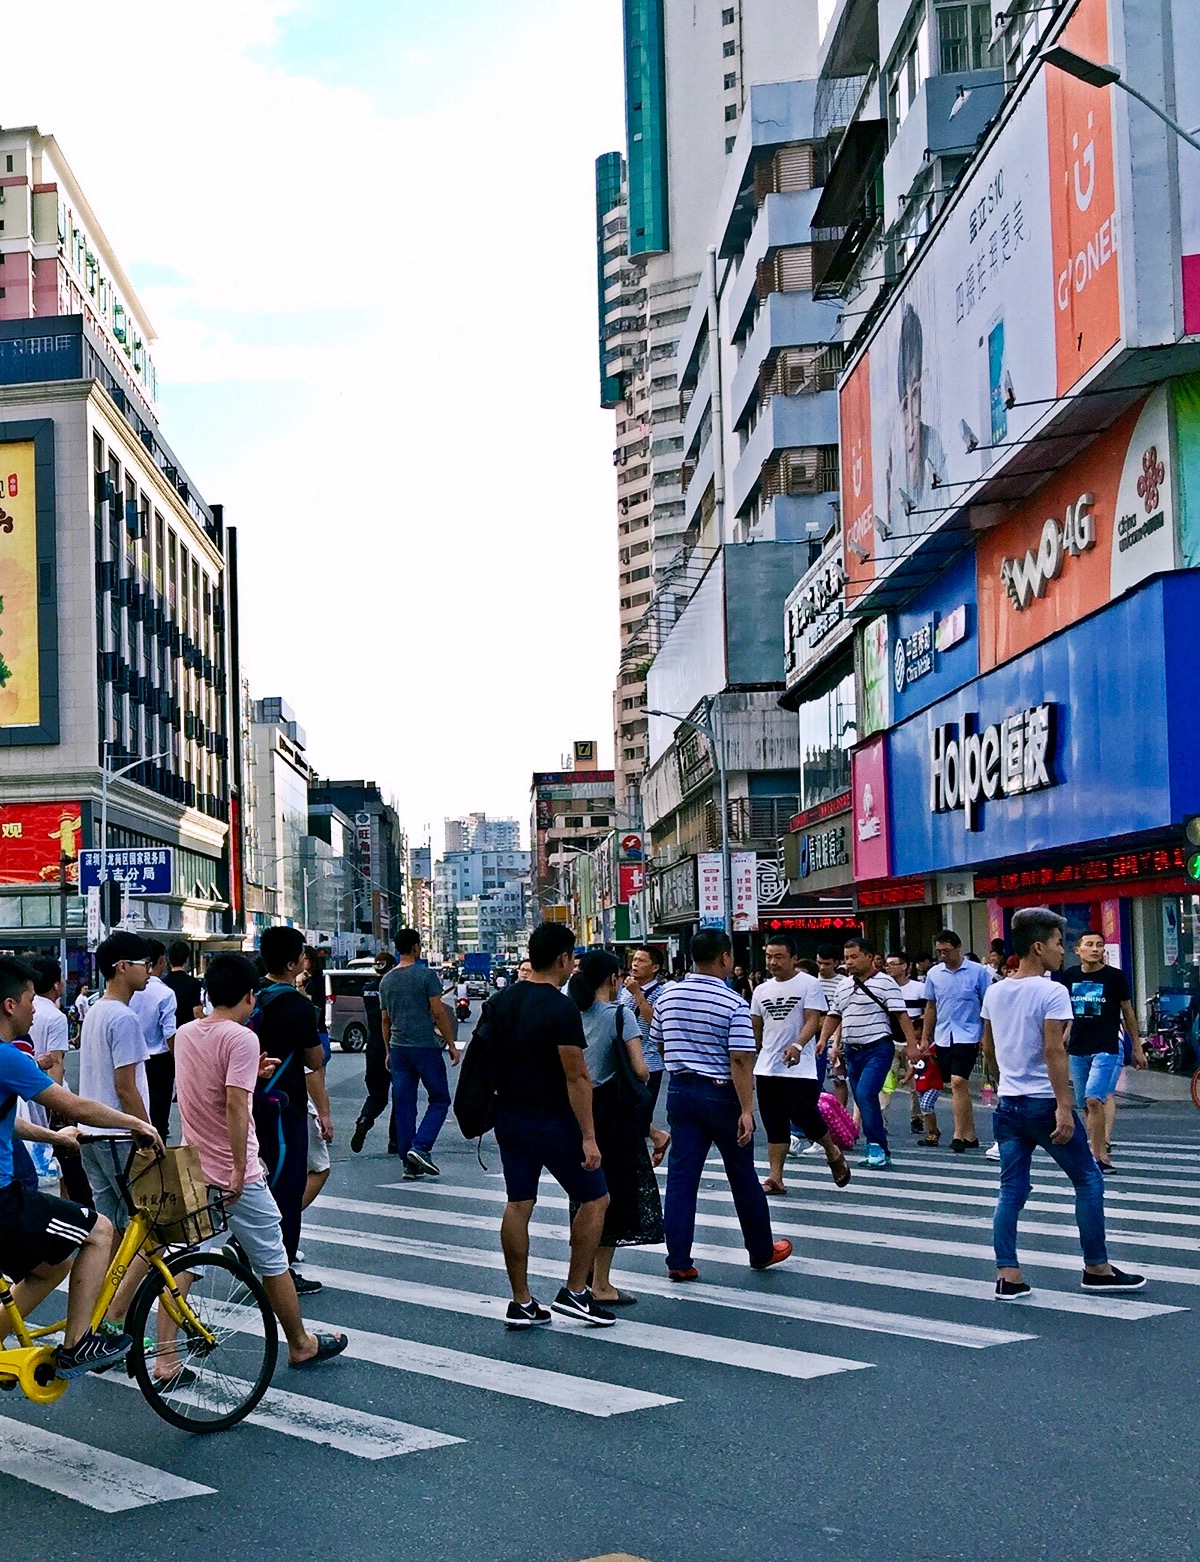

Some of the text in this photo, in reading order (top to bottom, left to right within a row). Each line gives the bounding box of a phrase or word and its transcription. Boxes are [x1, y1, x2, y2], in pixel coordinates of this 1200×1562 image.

[930, 713, 1000, 832] Holpe
[1000, 703, 1051, 797] 恒波
[85, 851, 166, 867] 深圳龙岗区国家税务局
[111, 1264, 126, 1286] ofo
